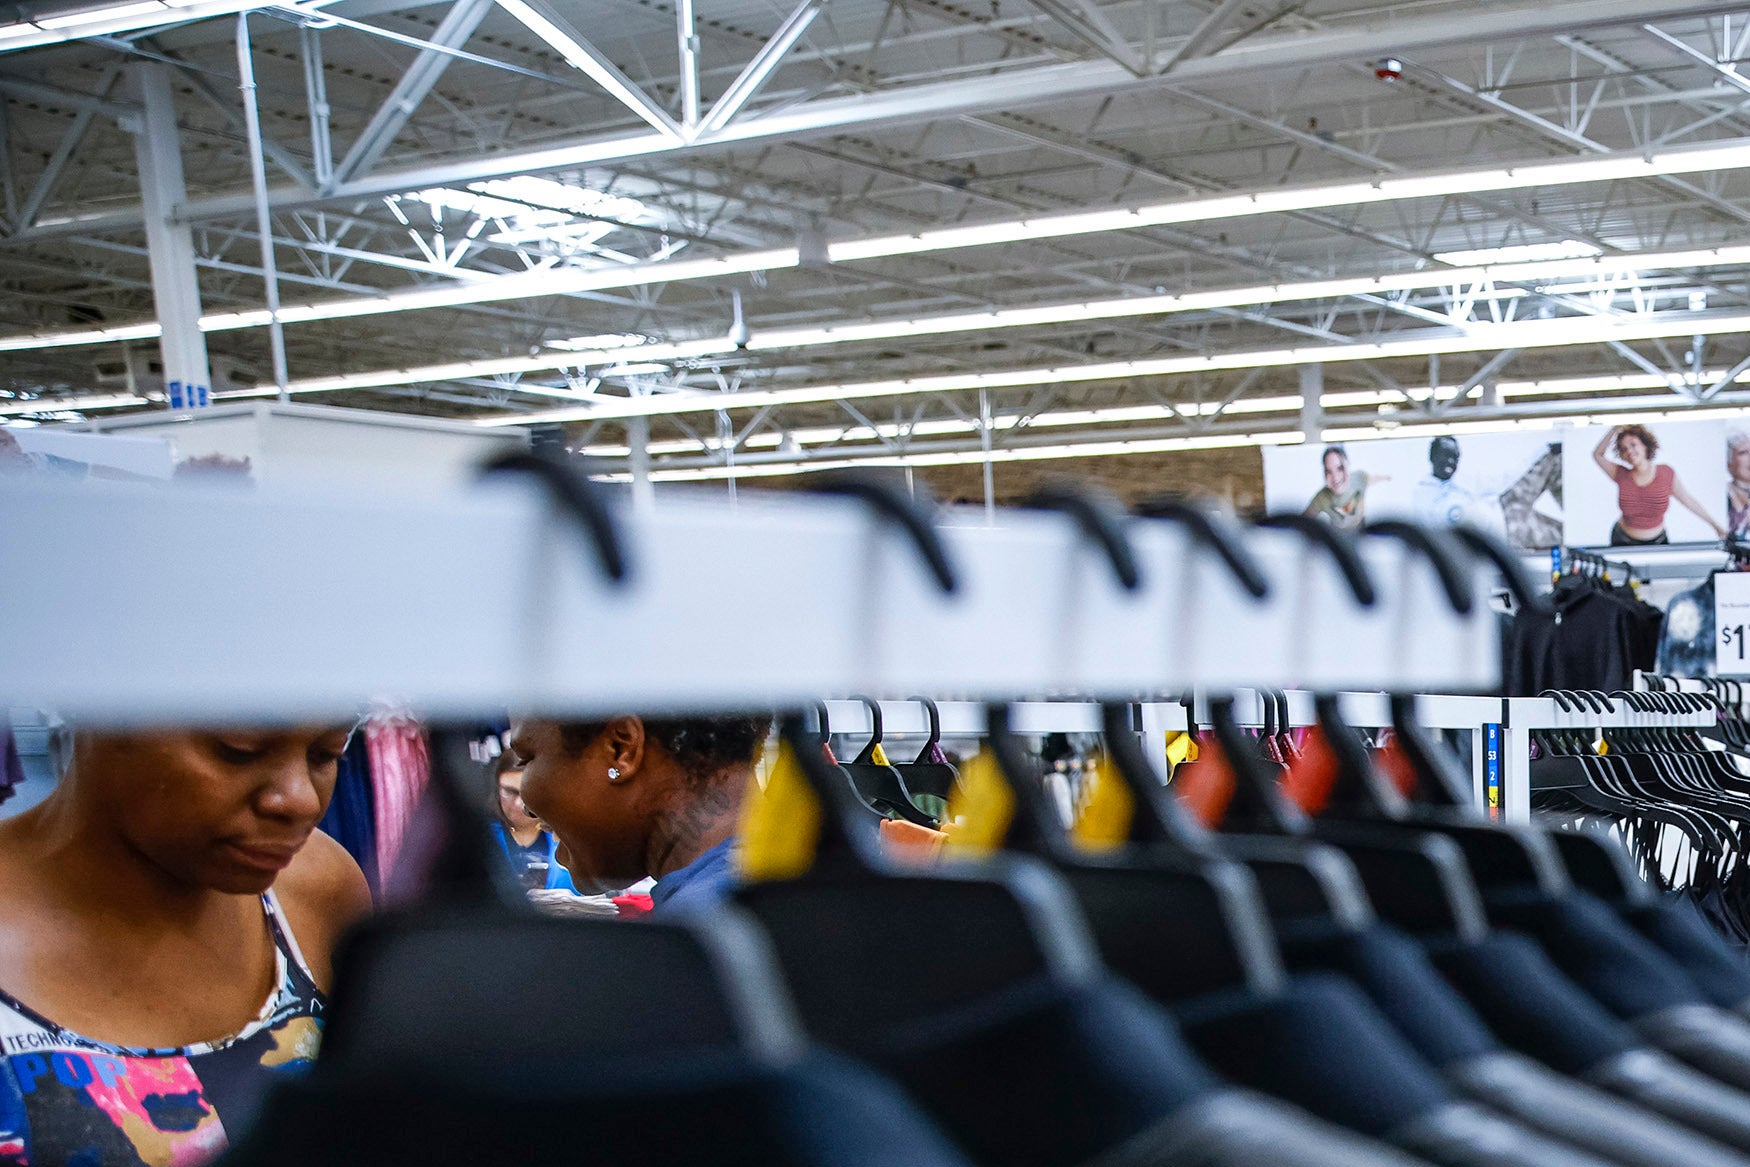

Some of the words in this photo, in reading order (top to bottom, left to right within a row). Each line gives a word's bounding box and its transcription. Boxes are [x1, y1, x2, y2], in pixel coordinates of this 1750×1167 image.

[1488, 751, 1497, 760] 53
[1490, 771, 1495, 781] 2
[10, 1051, 127, 1094] POP
